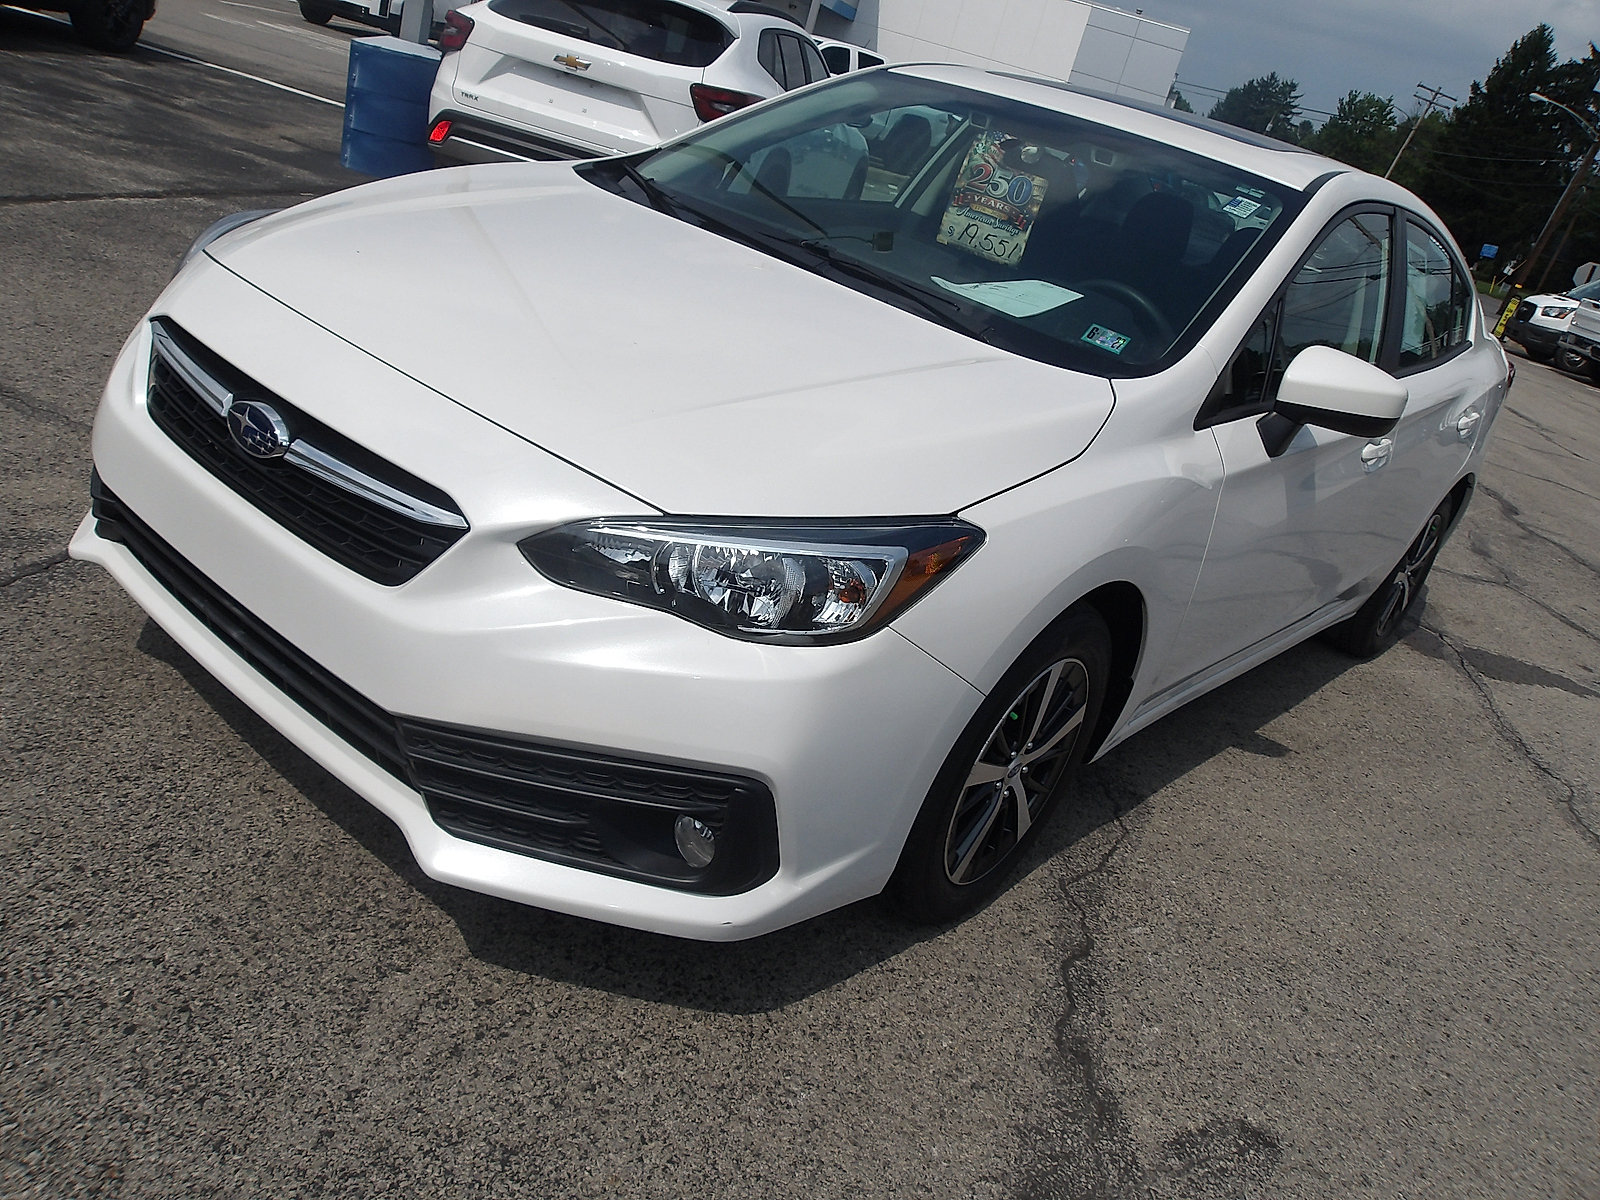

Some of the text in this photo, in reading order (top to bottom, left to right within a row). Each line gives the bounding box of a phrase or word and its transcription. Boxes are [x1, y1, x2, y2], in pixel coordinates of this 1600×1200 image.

[461, 91, 479, 101] TRAX
[965, 162, 1033, 206] 250
[974, 194, 1011, 212] YEARS
[957, 207, 994, 225] American
[993, 217, 1020, 236] Savings
[1111, 337, 1126, 349] 27
